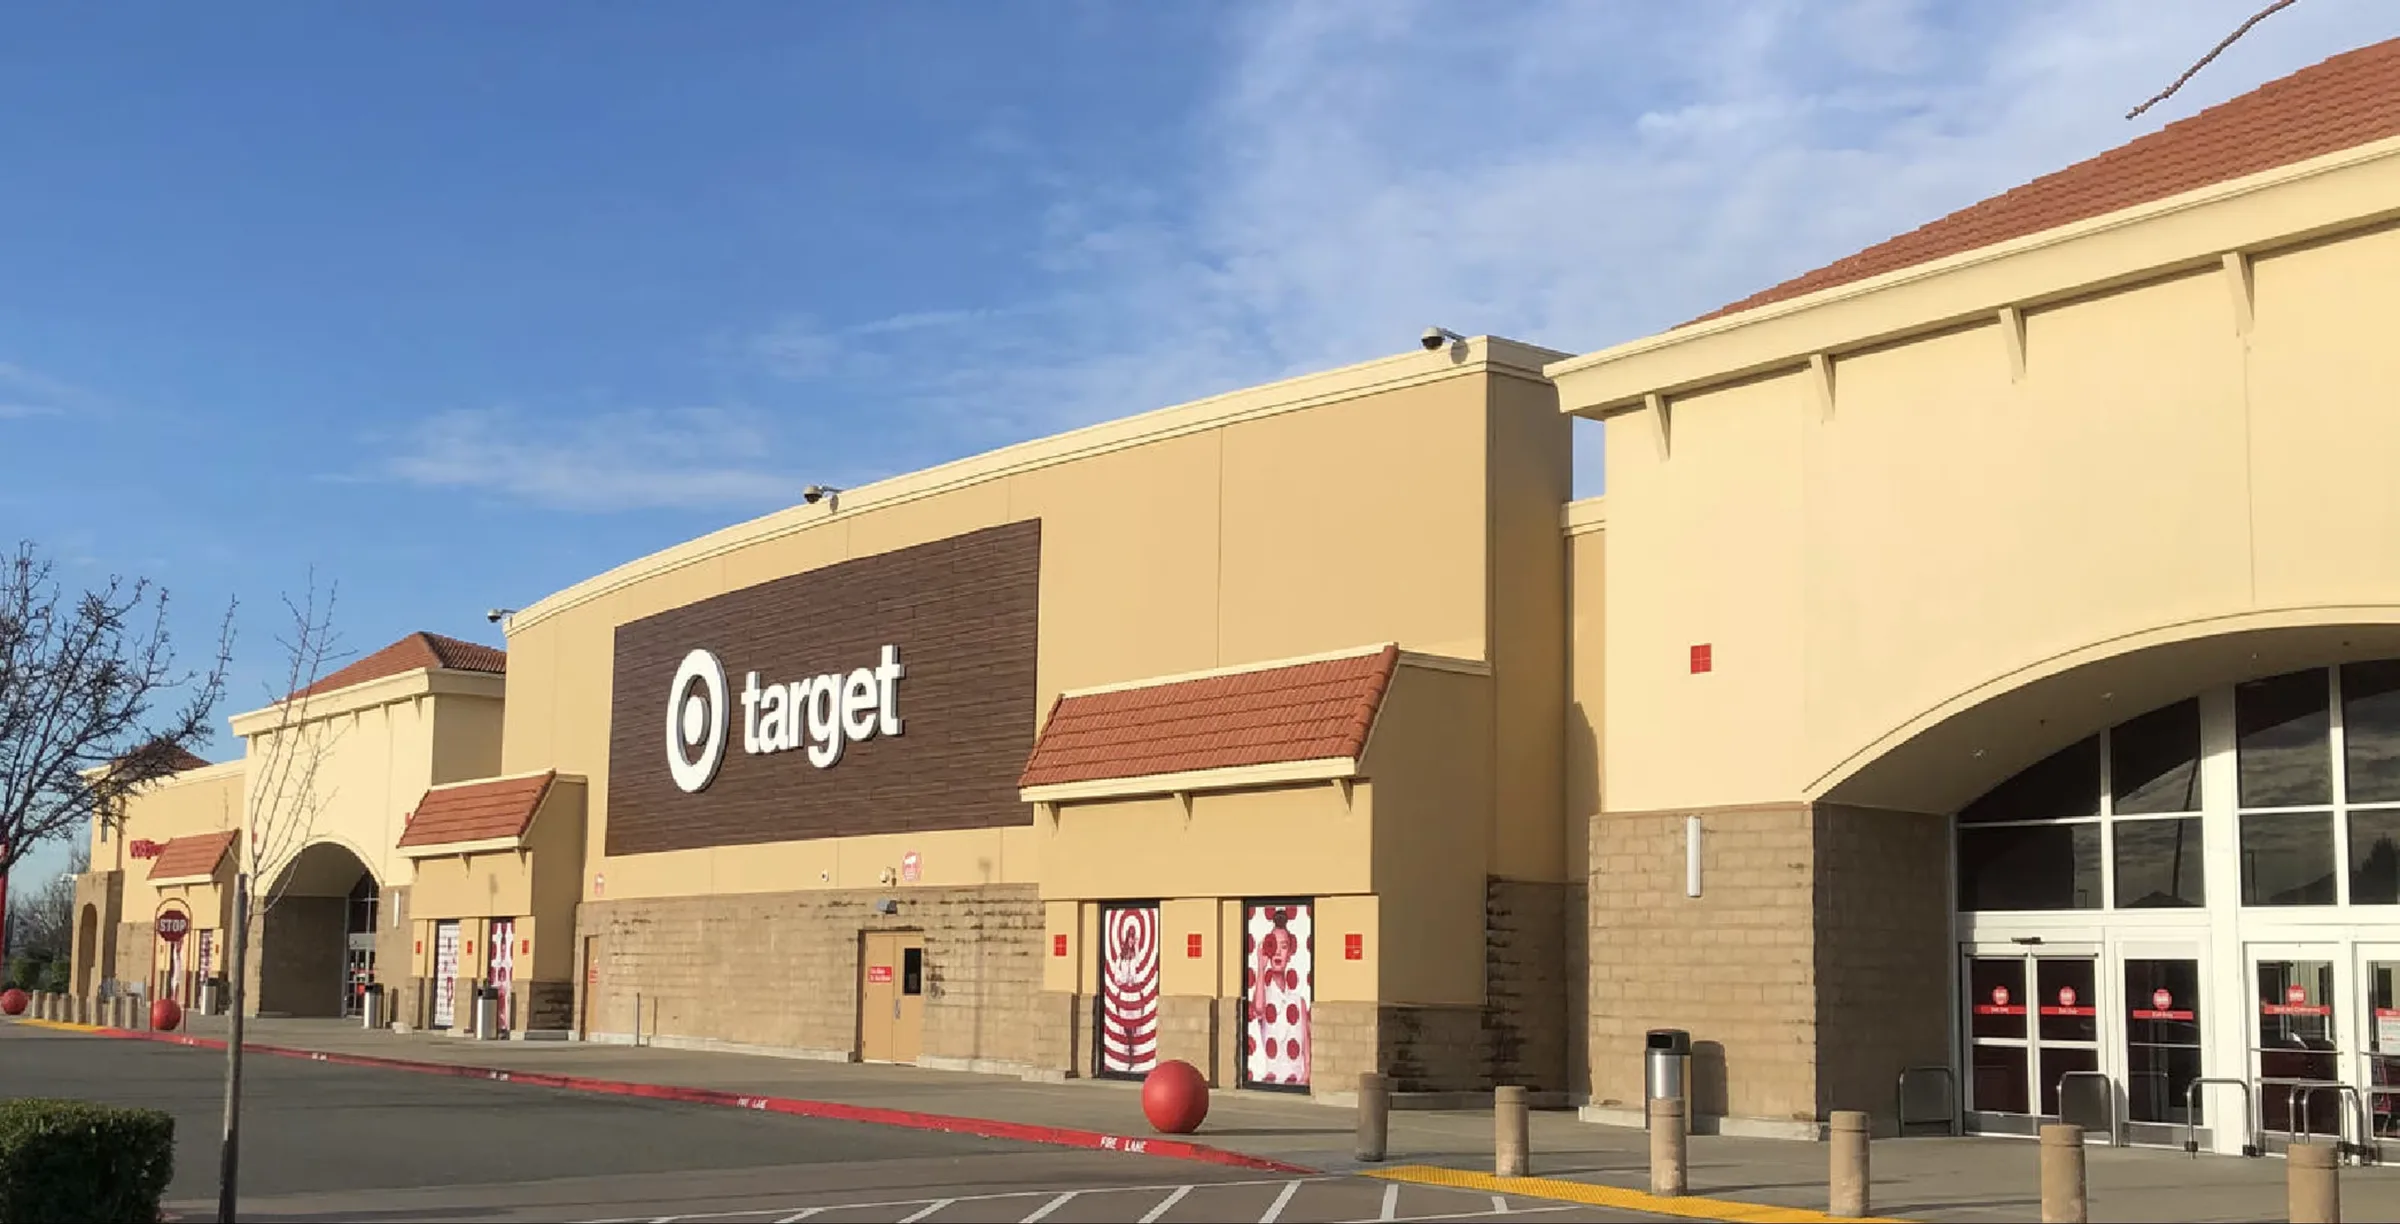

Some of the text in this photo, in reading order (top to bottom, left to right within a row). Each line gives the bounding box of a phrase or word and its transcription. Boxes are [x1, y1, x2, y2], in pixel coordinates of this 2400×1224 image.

[741, 645, 905, 768] target
[160, 919, 187, 932] STOP
[1100, 1136, 1147, 1153] FIRE LANE
